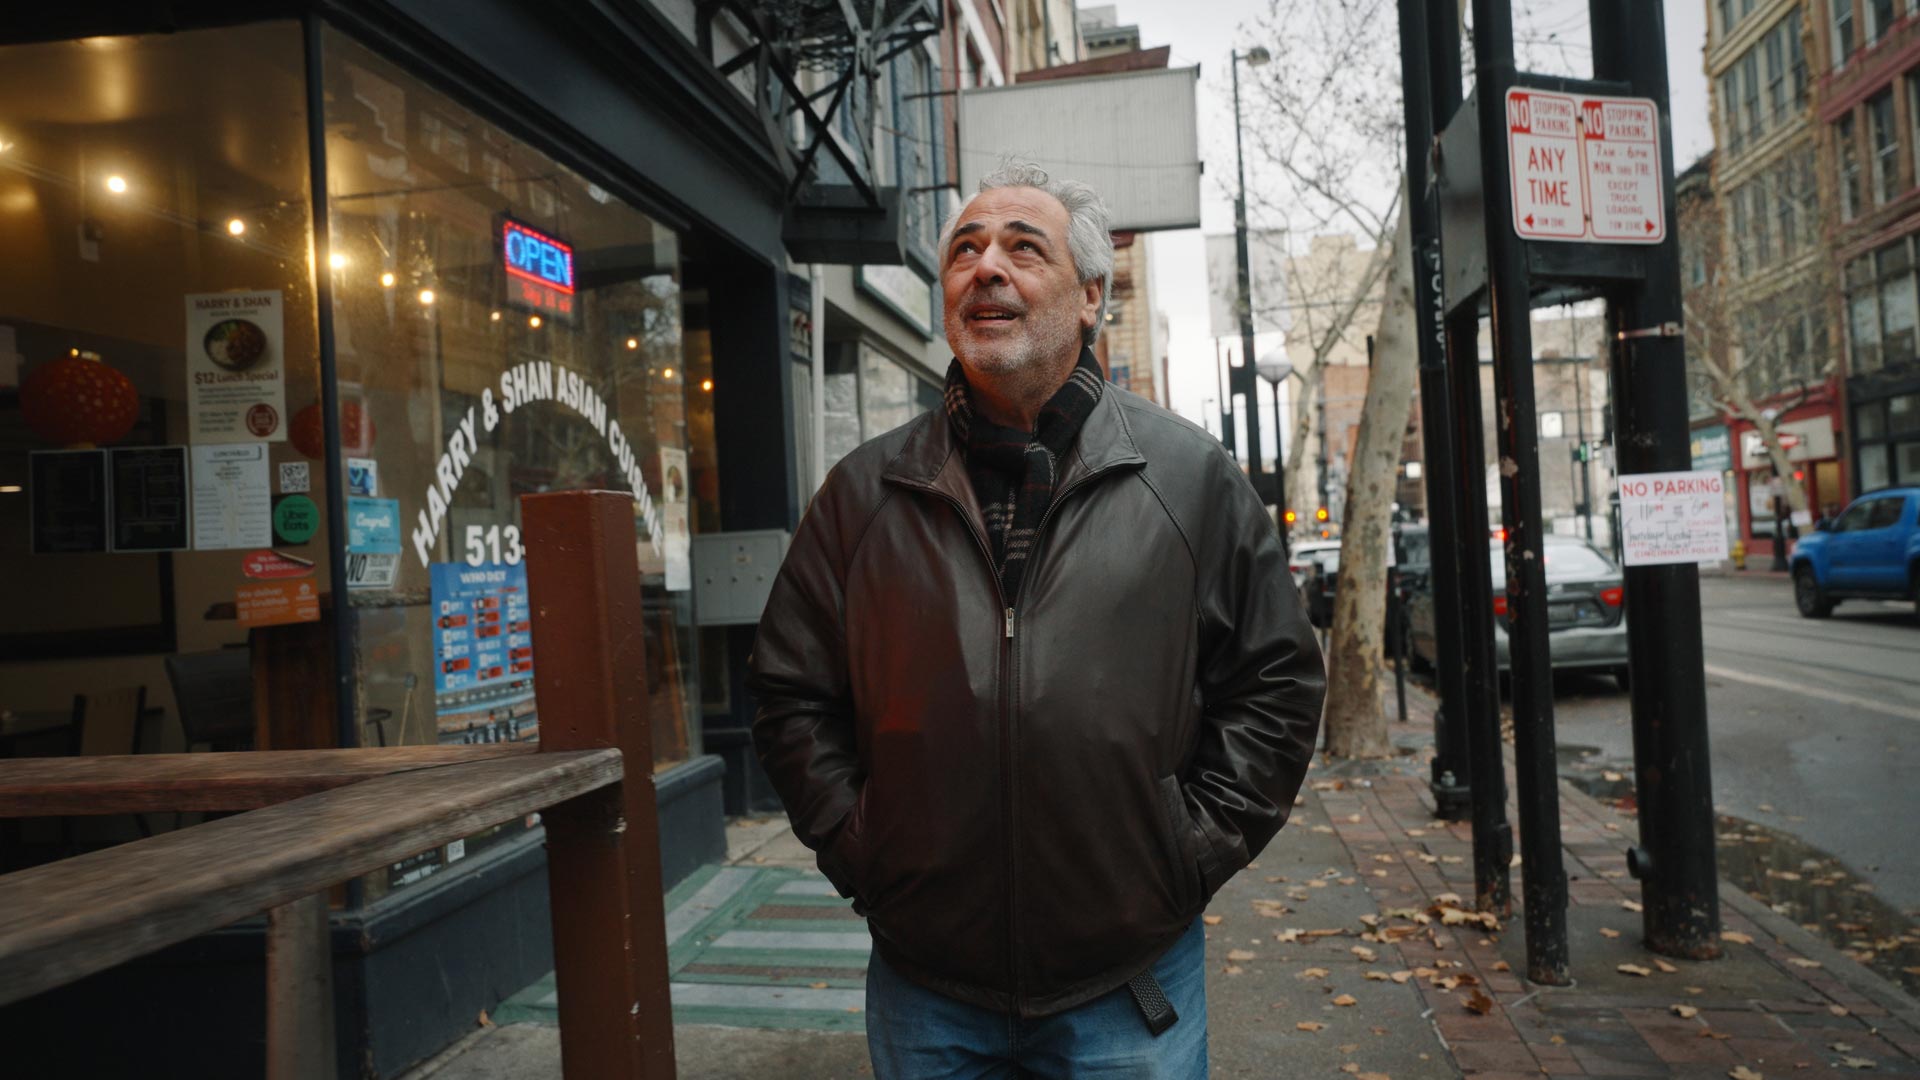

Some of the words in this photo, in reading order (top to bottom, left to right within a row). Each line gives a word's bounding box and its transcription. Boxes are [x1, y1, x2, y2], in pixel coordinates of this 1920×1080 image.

[1510, 98, 1529, 128] NO
[1534, 101, 1571, 116] STOPPING
[1607, 108, 1648, 122] STOPPING
[1536, 117, 1571, 133] PARKING
[1583, 107, 1604, 135] NO
[1609, 125, 1647, 138] PARKING
[1528, 146, 1565, 173] ANY
[1528, 179, 1571, 206] TIME
[1608, 180, 1638, 191] EXCEPT
[1610, 193, 1638, 202] TRUCK
[1606, 205, 1644, 216] LOADING
[507, 230, 571, 287] OPEN
[195, 298, 231, 309] HARRY
[243, 297, 271, 307] SHAN
[412, 405, 477, 568] HARRY
[482, 387, 499, 432] &
[501, 361, 552, 414] SHAN
[556, 366, 607, 437] ASIAN
[609, 419, 663, 557] CUISINE
[1622, 482, 1648, 497] NO
[1654, 478, 1721, 496] PARKING
